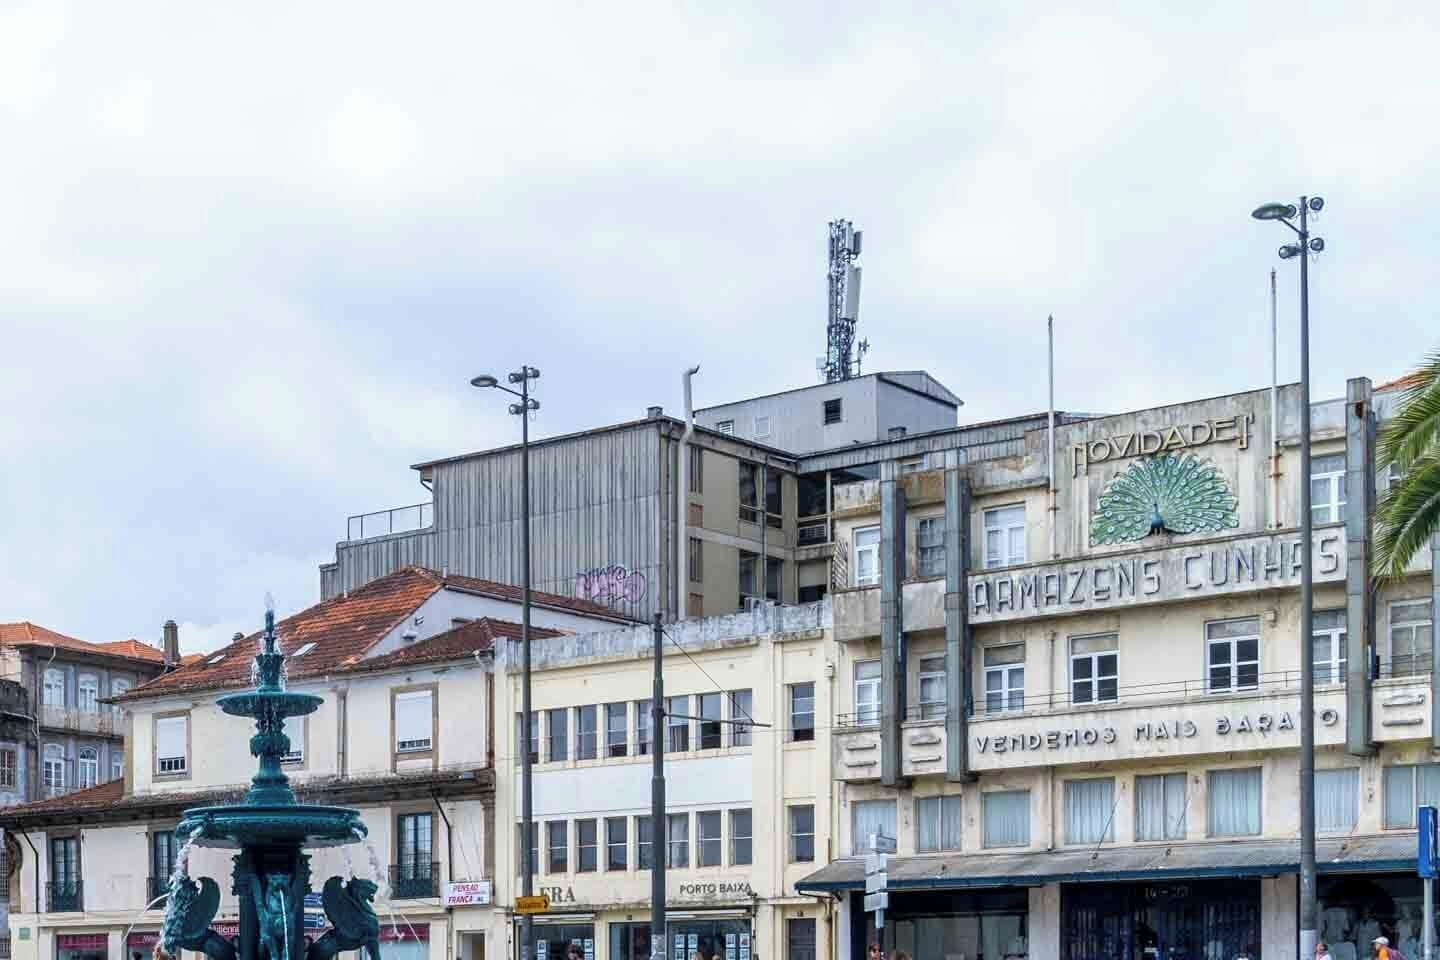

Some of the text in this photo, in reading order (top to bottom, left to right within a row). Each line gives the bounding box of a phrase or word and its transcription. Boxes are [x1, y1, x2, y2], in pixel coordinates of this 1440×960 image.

[974, 559, 1161, 617] ARMAZENS
[976, 705, 1339, 754] VENDEMOS MAIS BARAO
[679, 881, 754, 895] PORTO BAIXA
